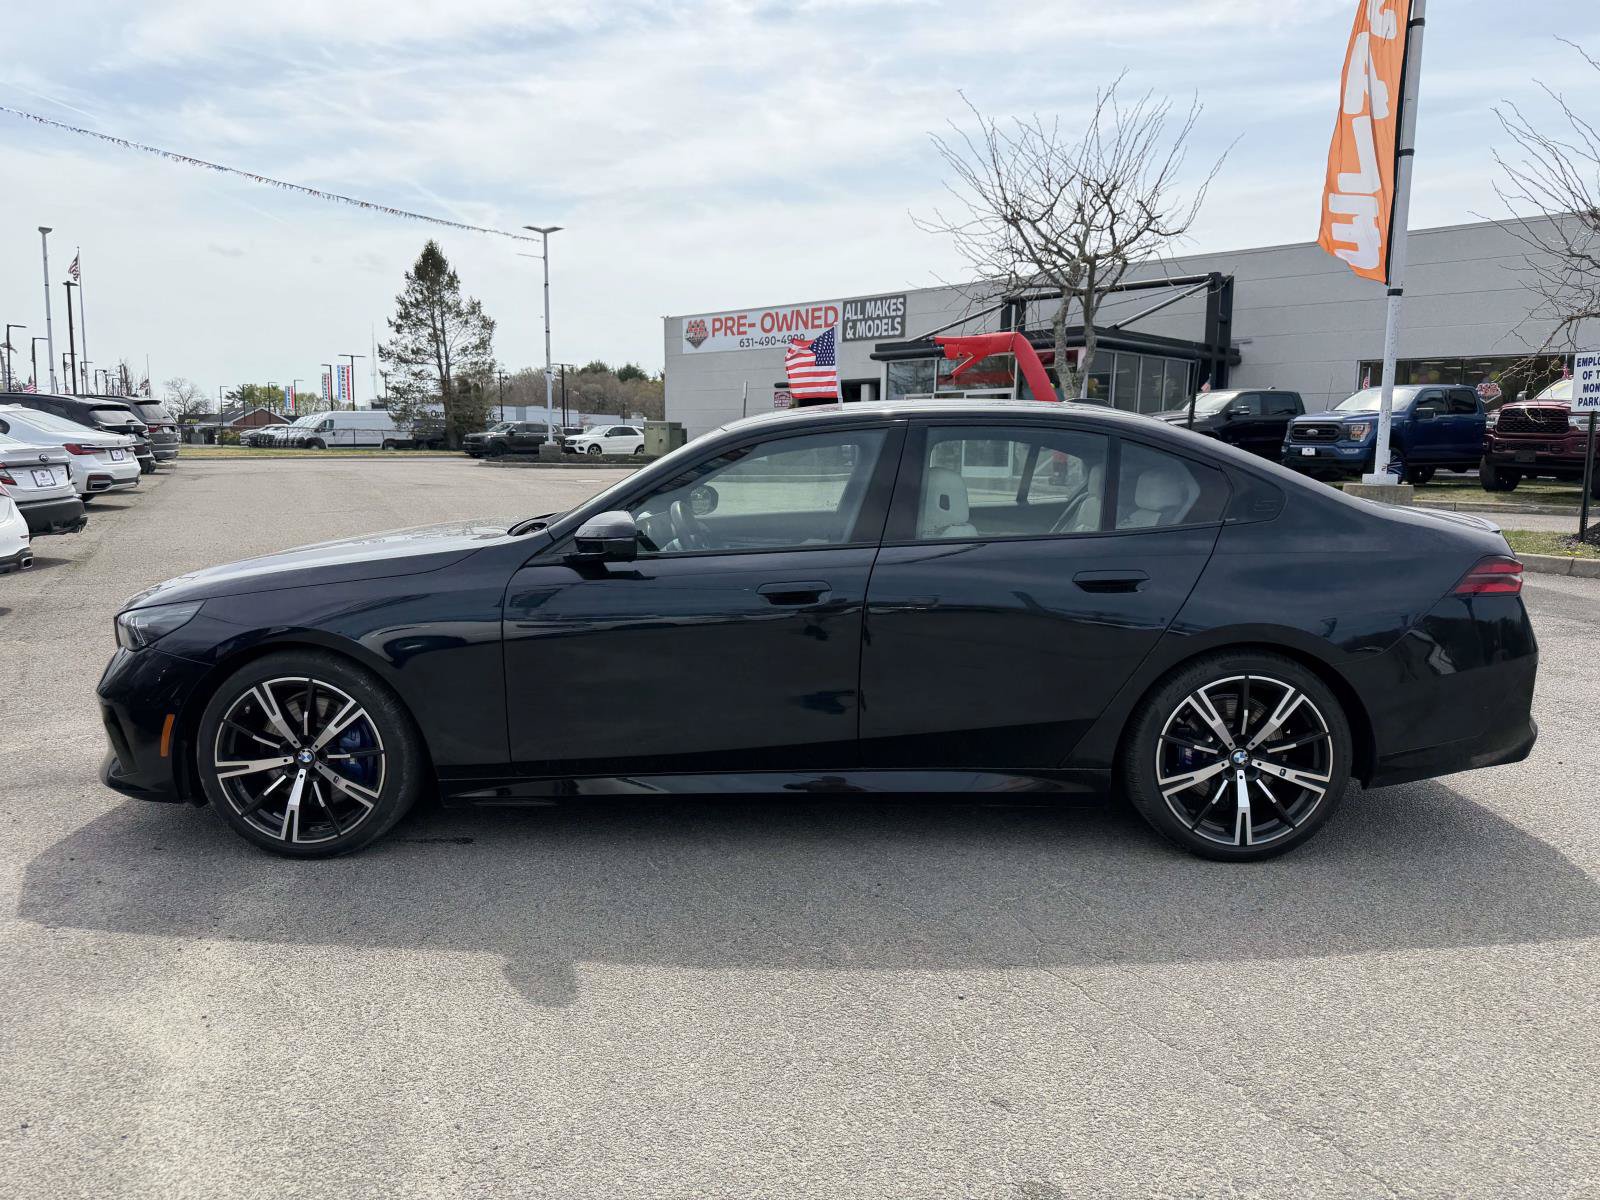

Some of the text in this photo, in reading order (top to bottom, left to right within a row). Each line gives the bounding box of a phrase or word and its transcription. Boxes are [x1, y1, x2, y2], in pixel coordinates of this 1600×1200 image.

[844, 297, 904, 320] ALL MAKES
[711, 315, 756, 337] PRE-
[760, 305, 839, 334] OWNED
[845, 317, 902, 339] & MODELS
[1582, 370, 1593, 380] OF
